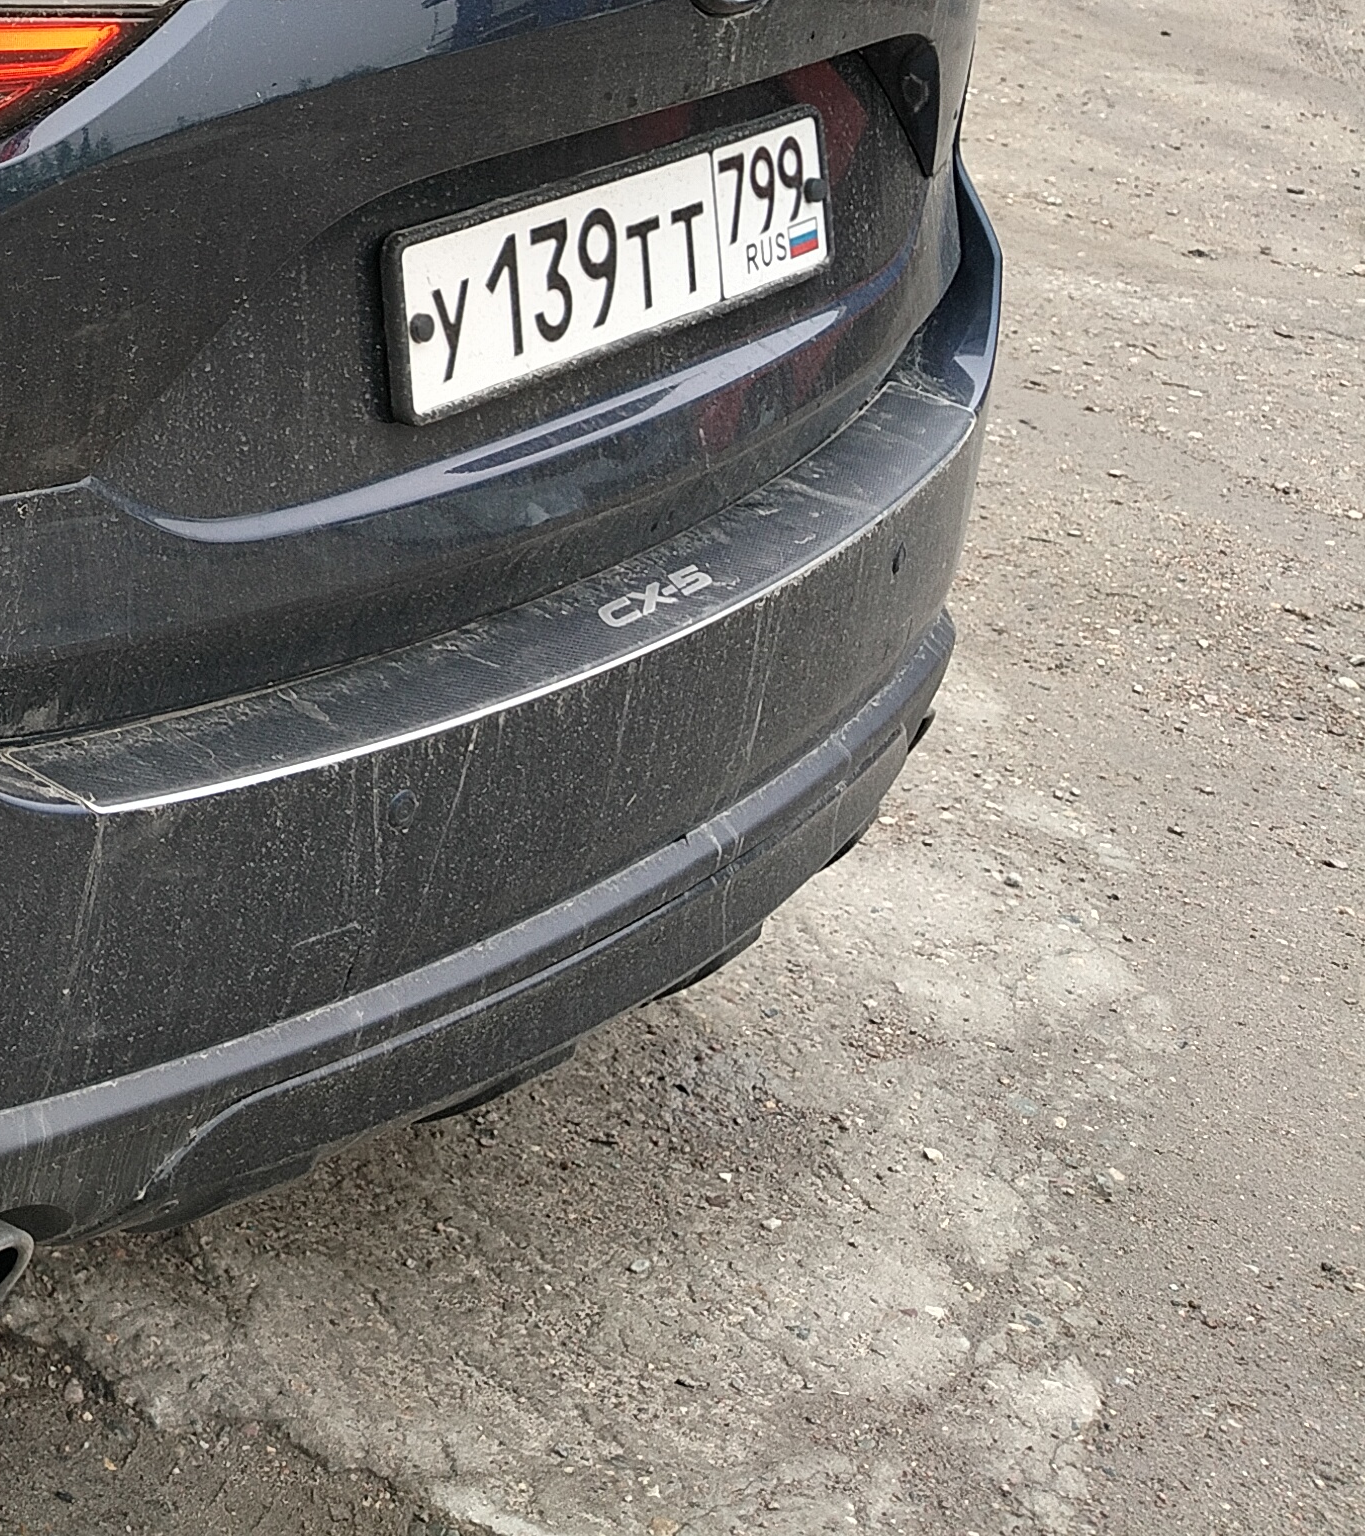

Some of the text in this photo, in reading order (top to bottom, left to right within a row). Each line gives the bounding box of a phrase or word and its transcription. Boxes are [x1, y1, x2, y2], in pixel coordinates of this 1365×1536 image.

[718, 136, 804, 246] 799
[745, 232, 788, 274] RUS
[597, 564, 713, 628] CX-5
